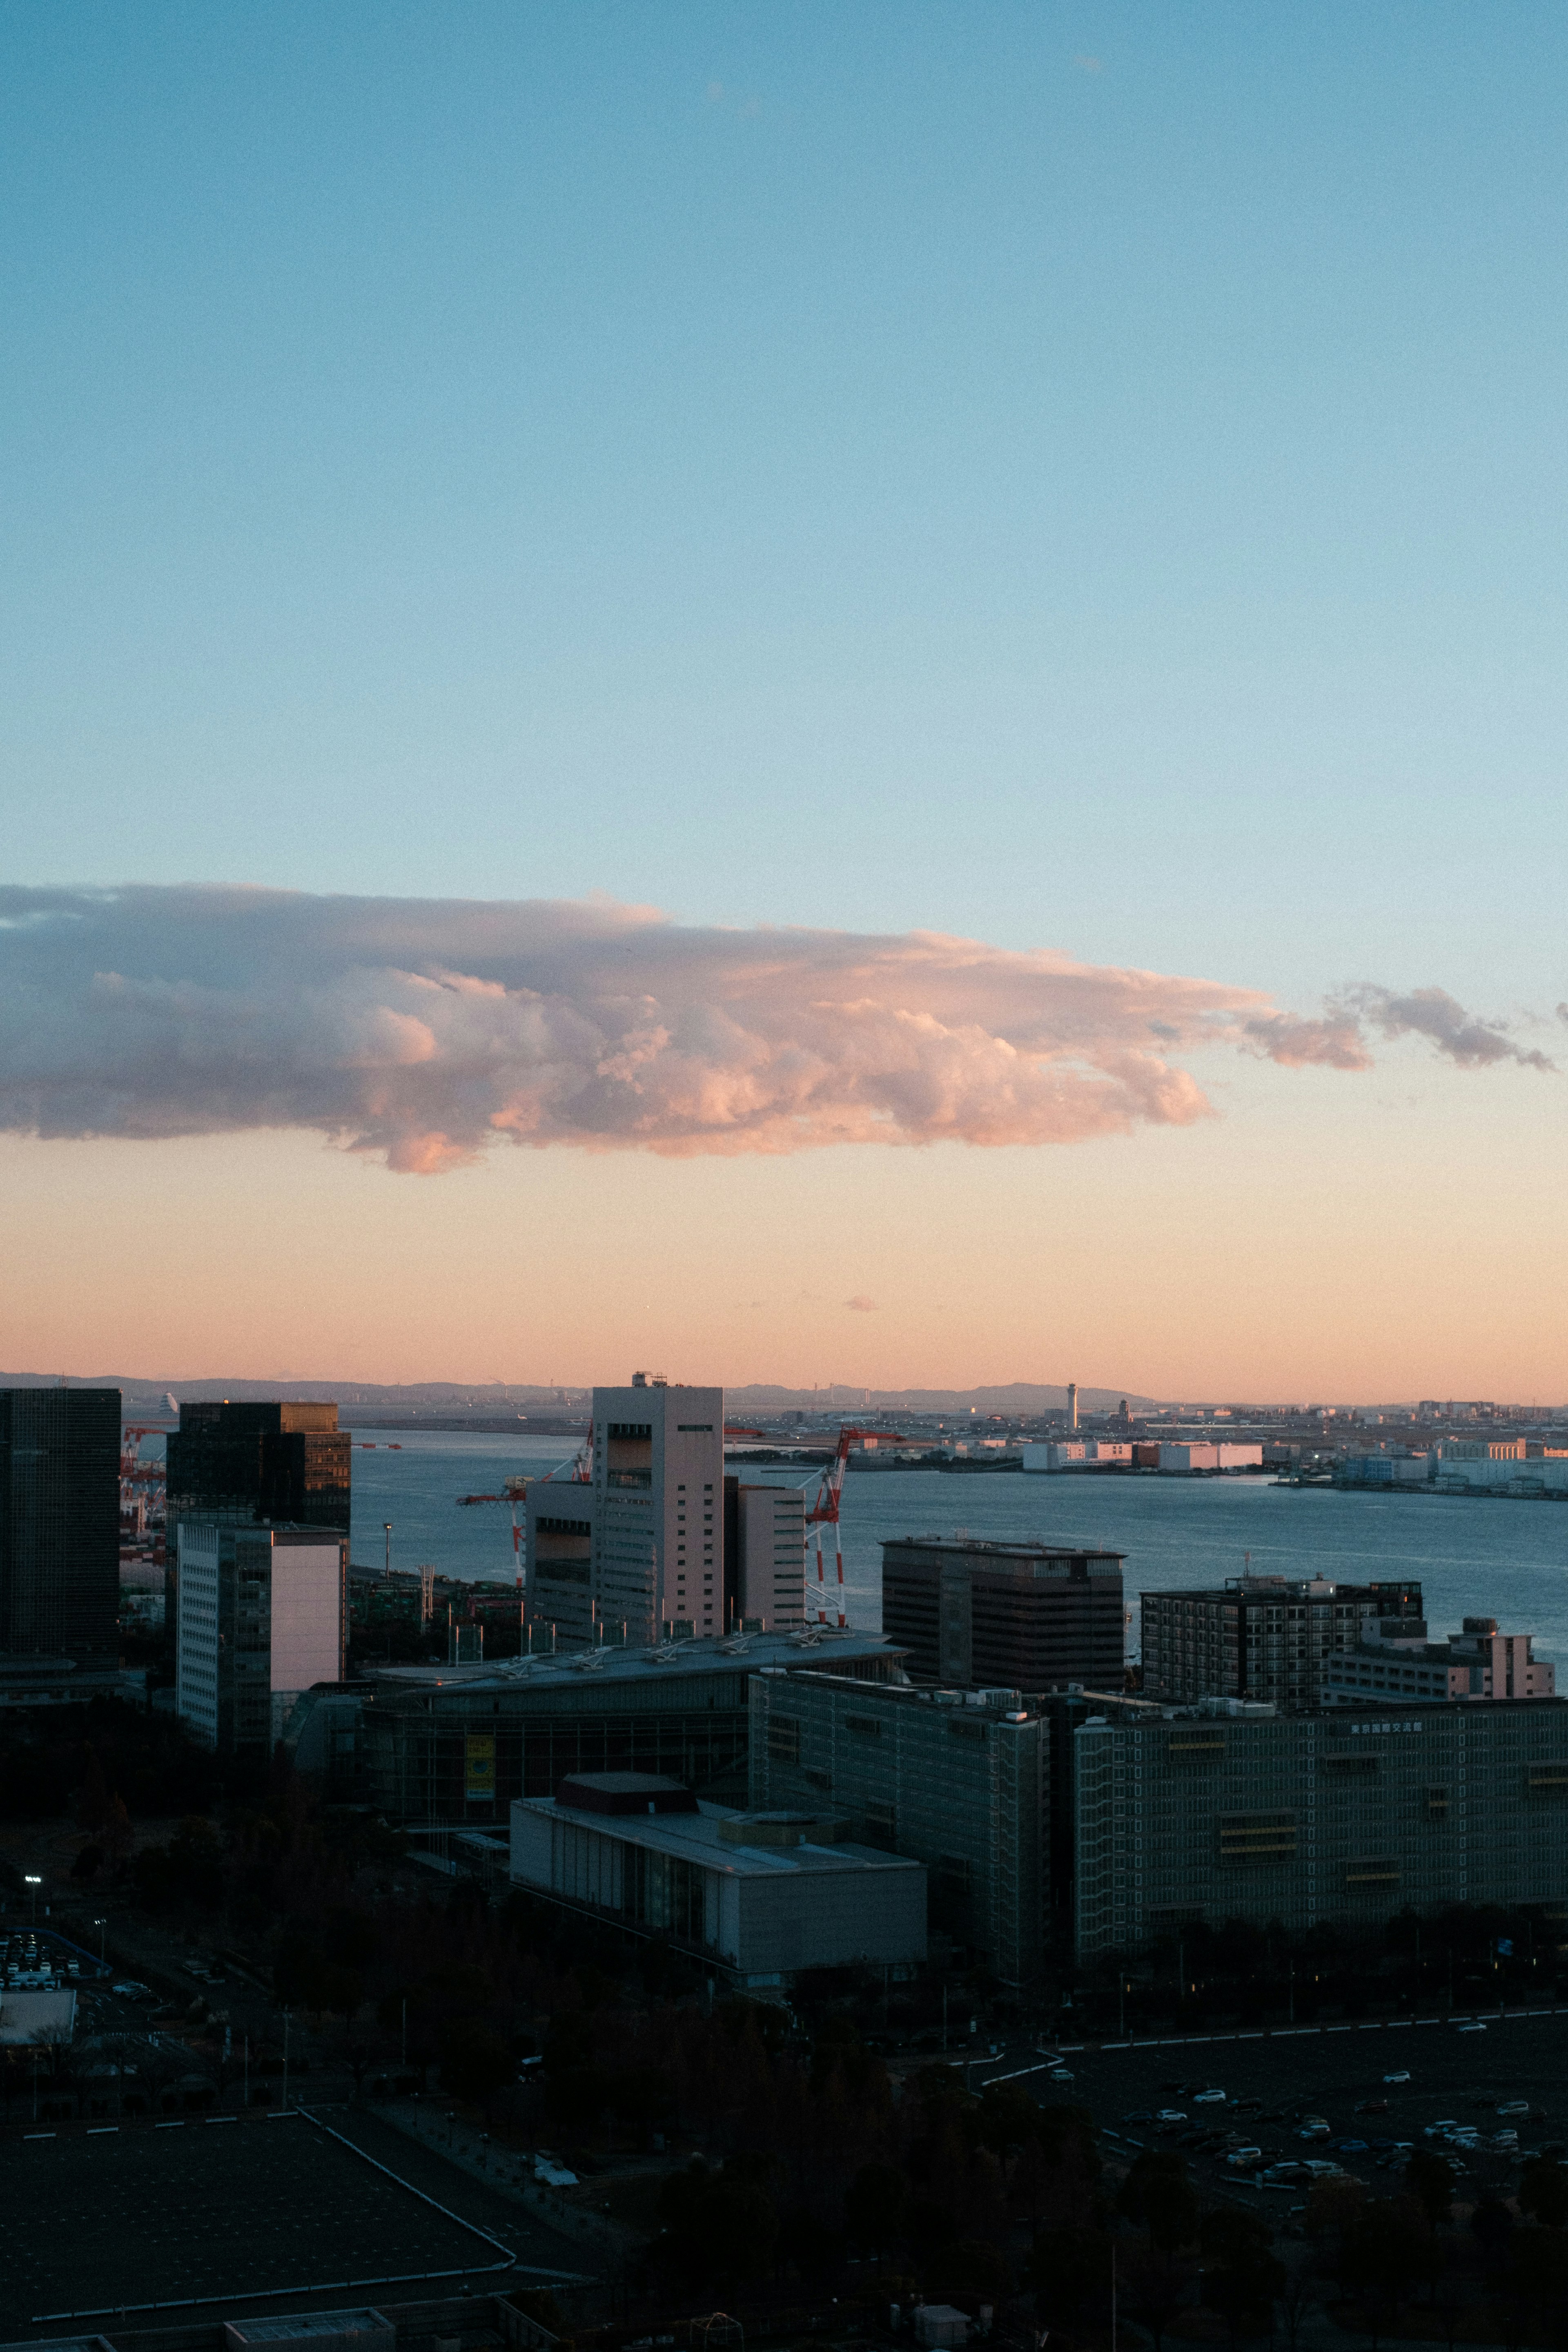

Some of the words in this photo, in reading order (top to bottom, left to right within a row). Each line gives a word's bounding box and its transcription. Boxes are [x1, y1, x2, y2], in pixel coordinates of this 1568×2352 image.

[1351, 1722, 1422, 1734] 東京国際交流館
